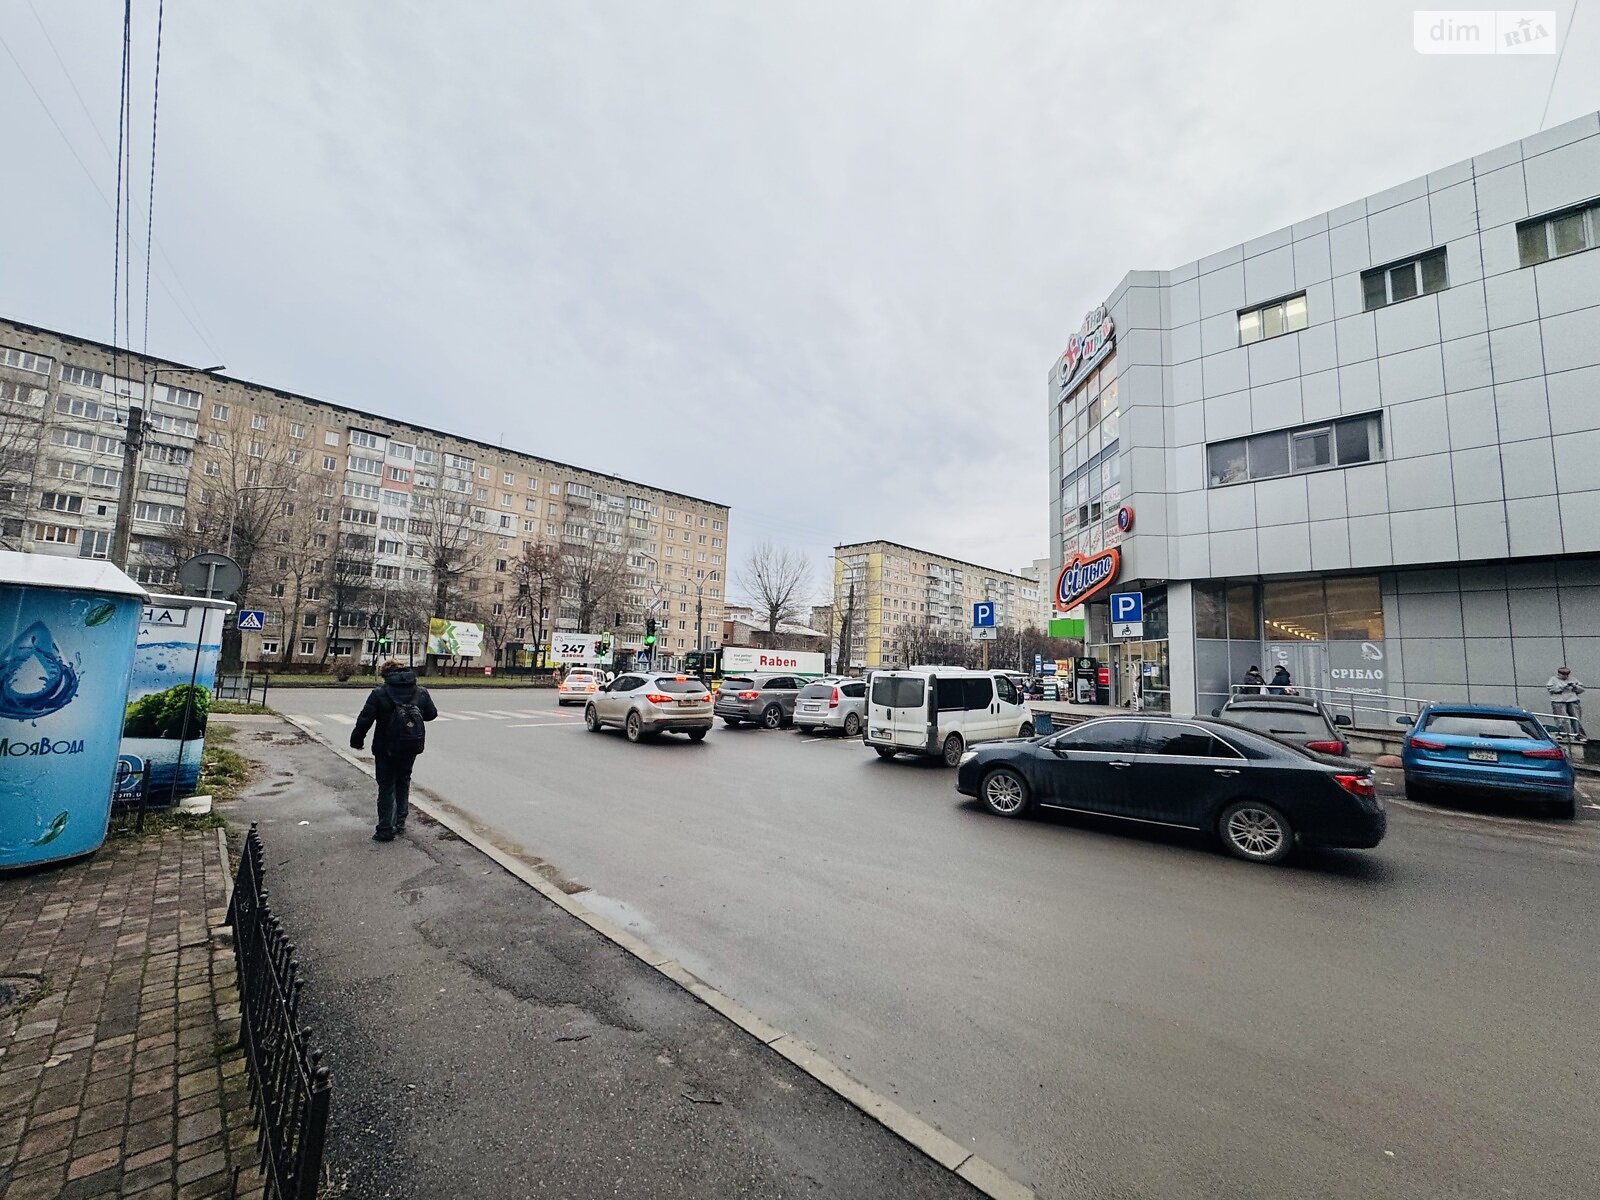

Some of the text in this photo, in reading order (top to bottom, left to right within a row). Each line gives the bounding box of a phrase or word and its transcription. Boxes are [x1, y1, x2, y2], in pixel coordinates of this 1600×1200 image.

[1060, 556, 1112, 603] Сільпо
[978, 605, 990, 624] P
[1119, 597, 1135, 619] P
[561, 644, 585, 654] 247
[759, 655, 797, 667] Raben
[1331, 668, 1384, 680] СРІБЛО
